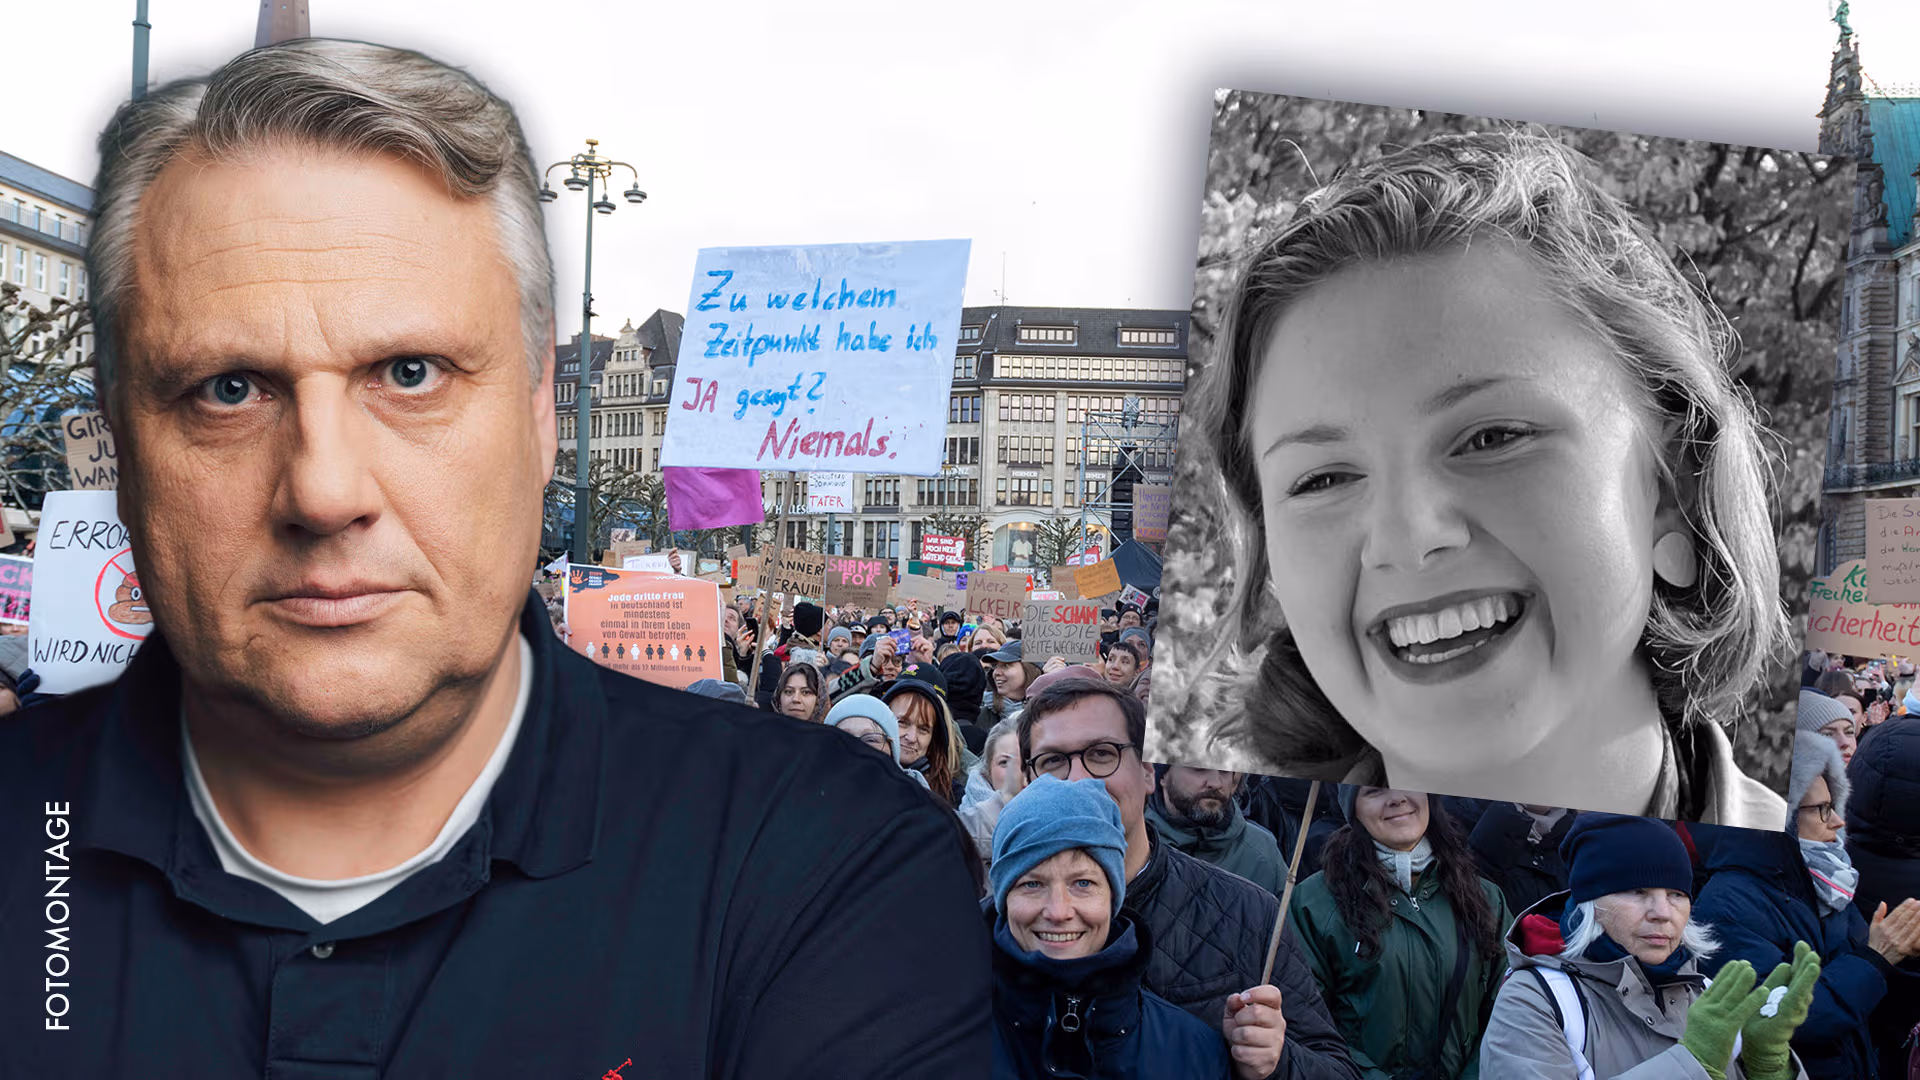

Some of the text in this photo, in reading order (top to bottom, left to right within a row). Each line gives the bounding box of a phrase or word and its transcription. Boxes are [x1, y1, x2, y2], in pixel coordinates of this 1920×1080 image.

[695, 269, 897, 312] Zu welchem
[703, 320, 937, 368] Zeitpunkt habe ich
[682, 377, 719, 413] JA
[756, 417, 897, 461] Niemals.
[827, 558, 882, 576] SHAME
[842, 572, 877, 588] FOR
[608, 592, 685, 602] Jede dritte Frau
[621, 601, 670, 609] Deutschland
[672, 601, 683, 609] ist
[623, 610, 671, 619] mindestens
[1025, 604, 1099, 625] DIE SCHAM
[600, 620, 691, 630] einmal in ihrem Leben
[1024, 624, 1096, 639] MUSS DIE
[602, 631, 617, 639] von
[619, 630, 646, 639] Gewalt
[34, 638, 88, 663] WIRD
[1024, 640, 1052, 654] SEITE
